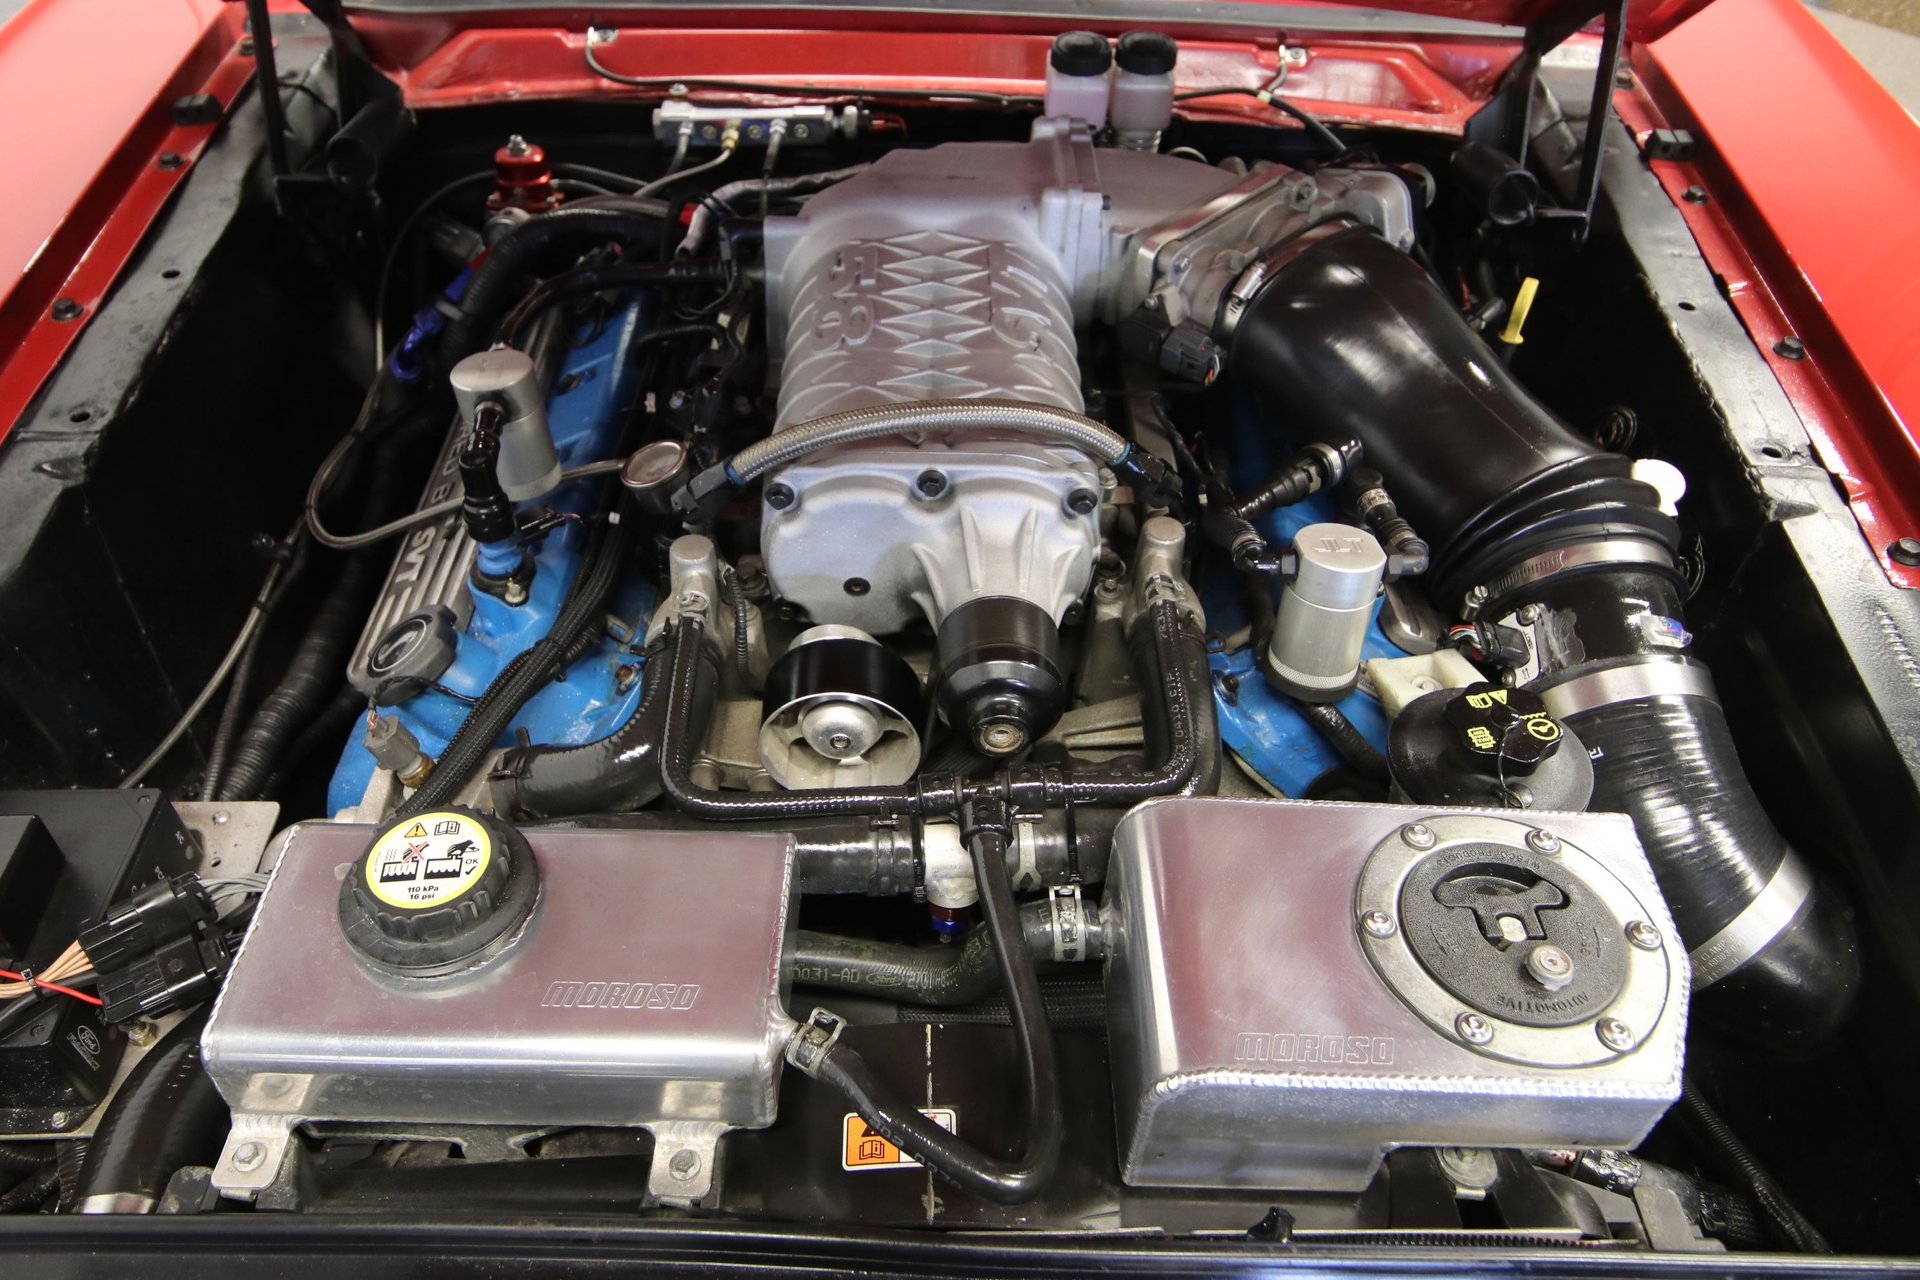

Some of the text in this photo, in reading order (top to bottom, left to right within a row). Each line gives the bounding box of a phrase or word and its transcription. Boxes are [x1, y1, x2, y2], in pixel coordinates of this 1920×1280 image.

[395, 526, 434, 584] SVT
[1313, 537, 1364, 553] JLT
[541, 981, 700, 1010] MOROSO
[1494, 991, 1590, 1014] AUTOMOTIVE
[1234, 1032, 1394, 1065] MOROSO
